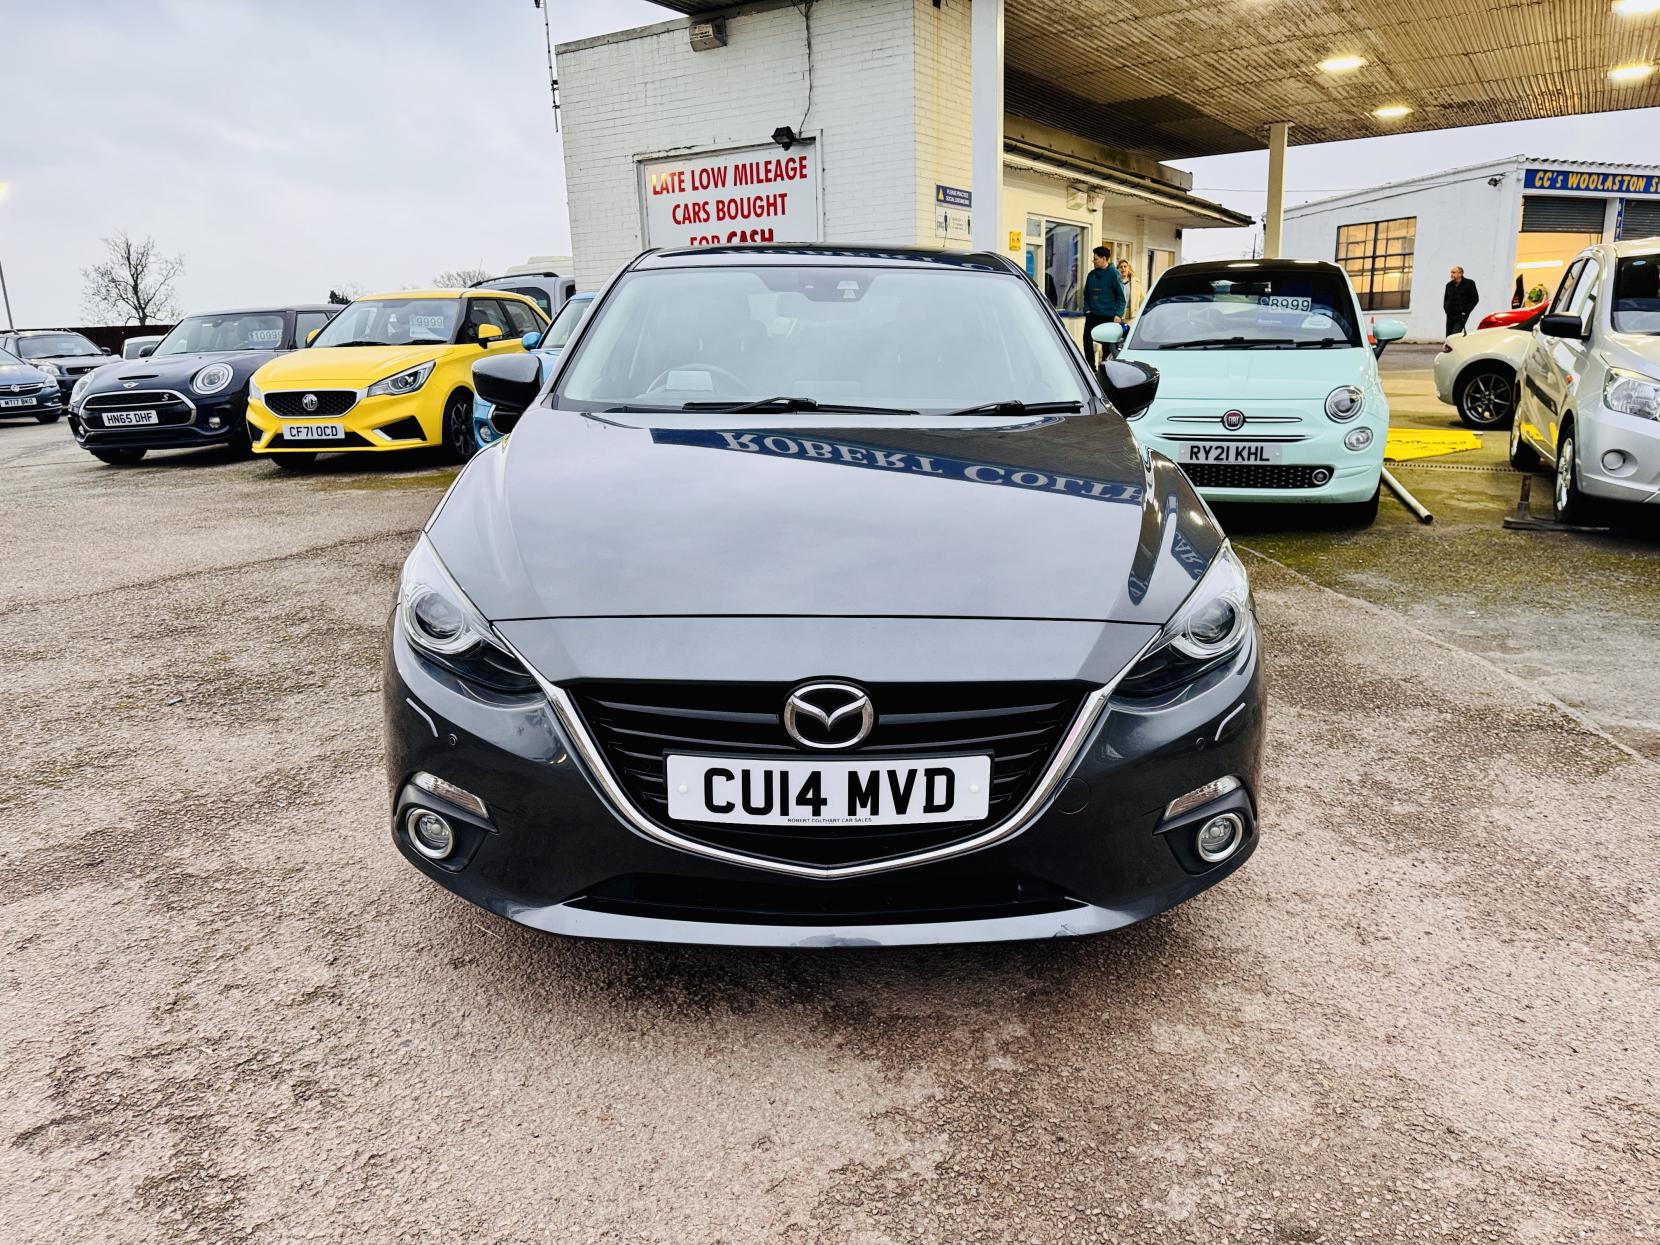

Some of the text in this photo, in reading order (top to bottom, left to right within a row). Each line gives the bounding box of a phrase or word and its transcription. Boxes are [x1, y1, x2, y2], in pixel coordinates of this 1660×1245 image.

[652, 155, 808, 196] LATE LOW MILEAGE
[1567, 172, 1647, 192] WOOLASTON
[1649, 177, 1660, 192] S
[672, 193, 788, 225] CARS BOUGHT
[106, 412, 153, 424] HN65 DHF
[1227, 415, 1240, 425] FIAT
[289, 426, 314, 437] CF71
[1189, 445, 1271, 462] RY21 KHL
[704, 767, 956, 817] CU14 MVD
